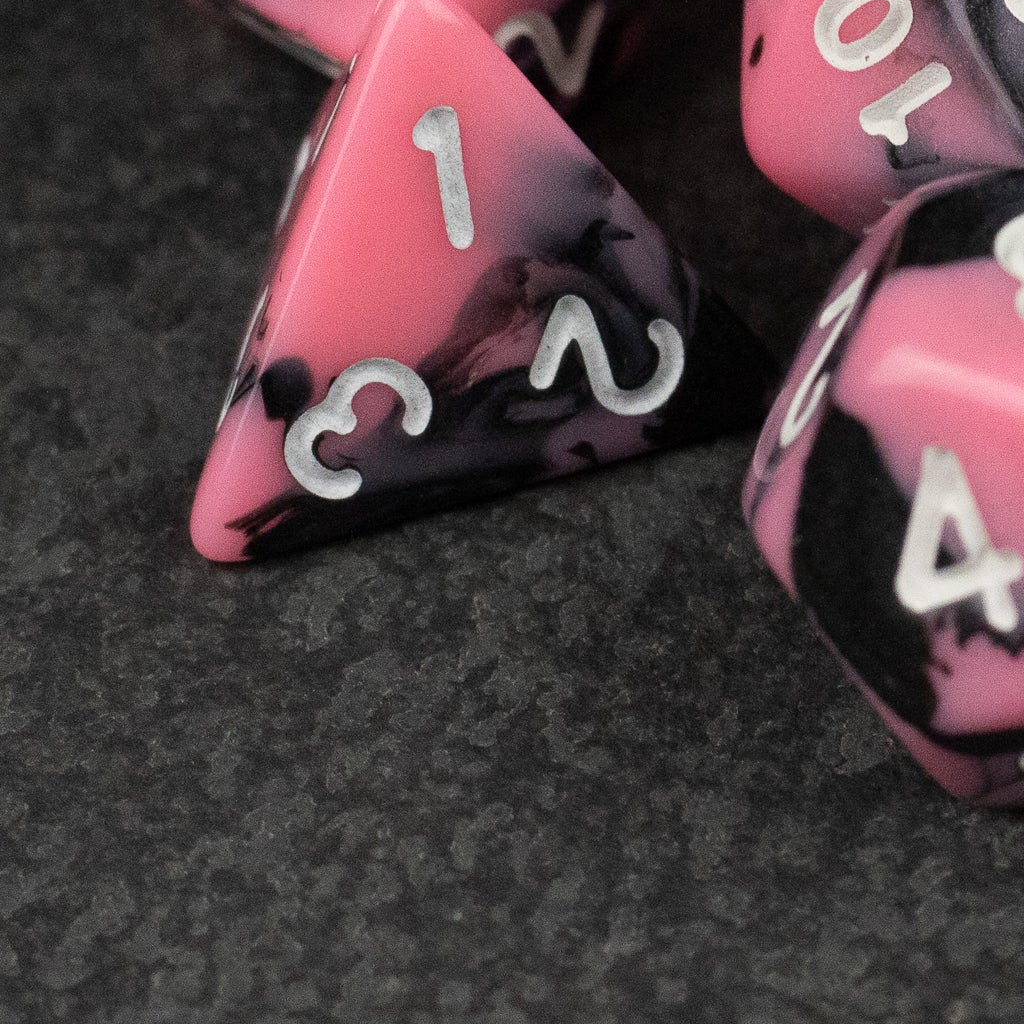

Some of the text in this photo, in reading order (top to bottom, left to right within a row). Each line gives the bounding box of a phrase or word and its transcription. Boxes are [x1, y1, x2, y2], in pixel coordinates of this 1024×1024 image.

[411, 105, 475, 250] 1
[529, 294, 685, 416] 2
[283, 357, 433, 499] 3
[895, 445, 1024, 633] 4
